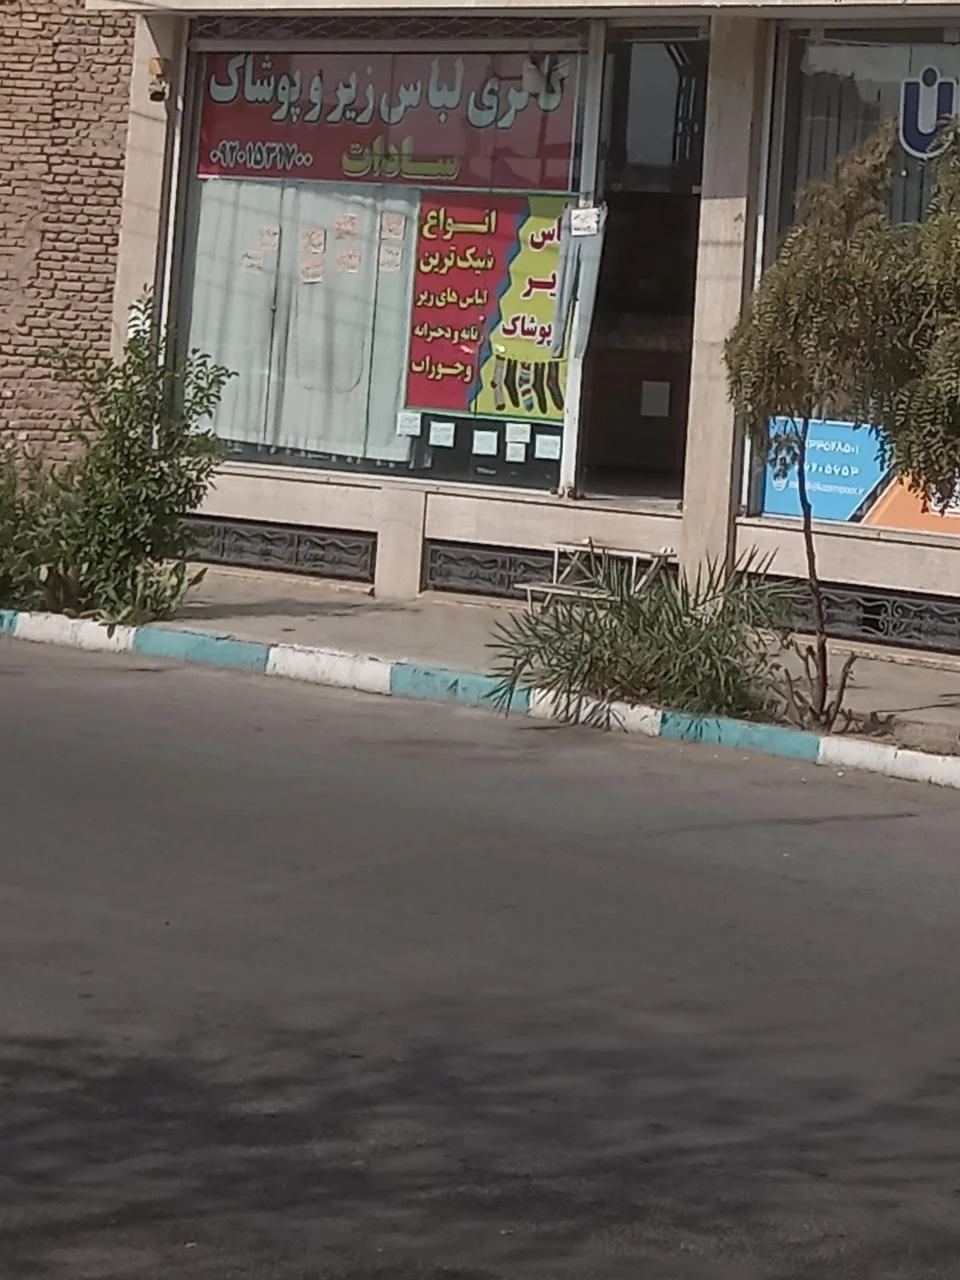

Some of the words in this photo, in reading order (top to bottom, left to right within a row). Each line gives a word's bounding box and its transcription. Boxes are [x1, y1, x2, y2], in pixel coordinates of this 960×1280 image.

[209, 52, 302, 122] پوشاک
[304, 74, 322, 122] و
[326, 66, 373, 123] زیر
[380, 56, 464, 124] لباس
[341, 135, 461, 180] سادات
[422, 206, 498, 241] انواع
